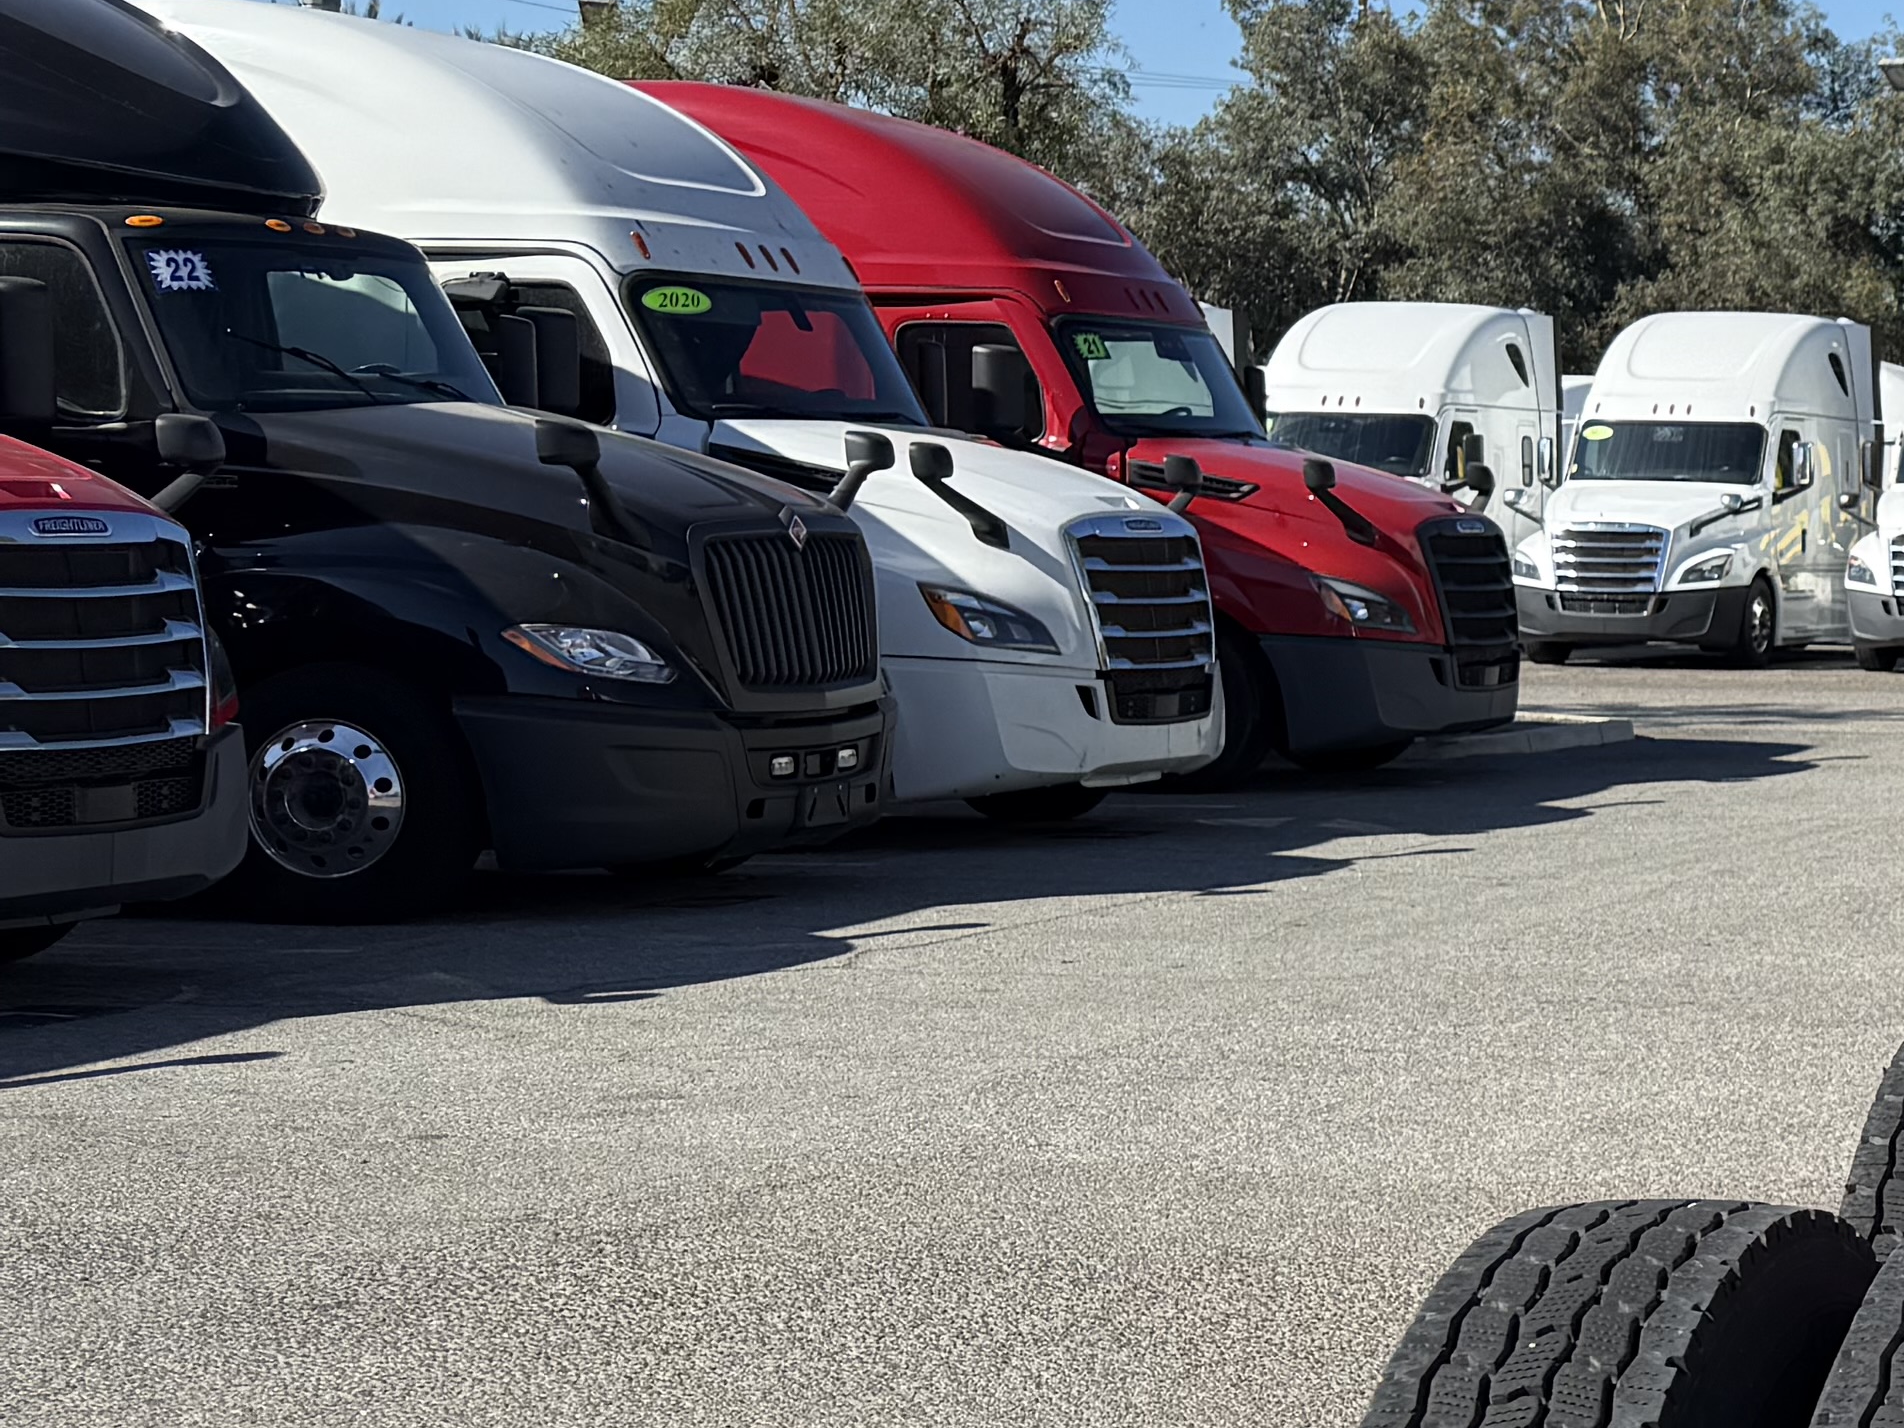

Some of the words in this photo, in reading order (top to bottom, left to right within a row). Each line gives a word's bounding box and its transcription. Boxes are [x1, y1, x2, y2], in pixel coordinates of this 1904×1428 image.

[165, 256, 201, 282] 22
[658, 291, 701, 308] 2020
[1082, 336, 1101, 355] 21
